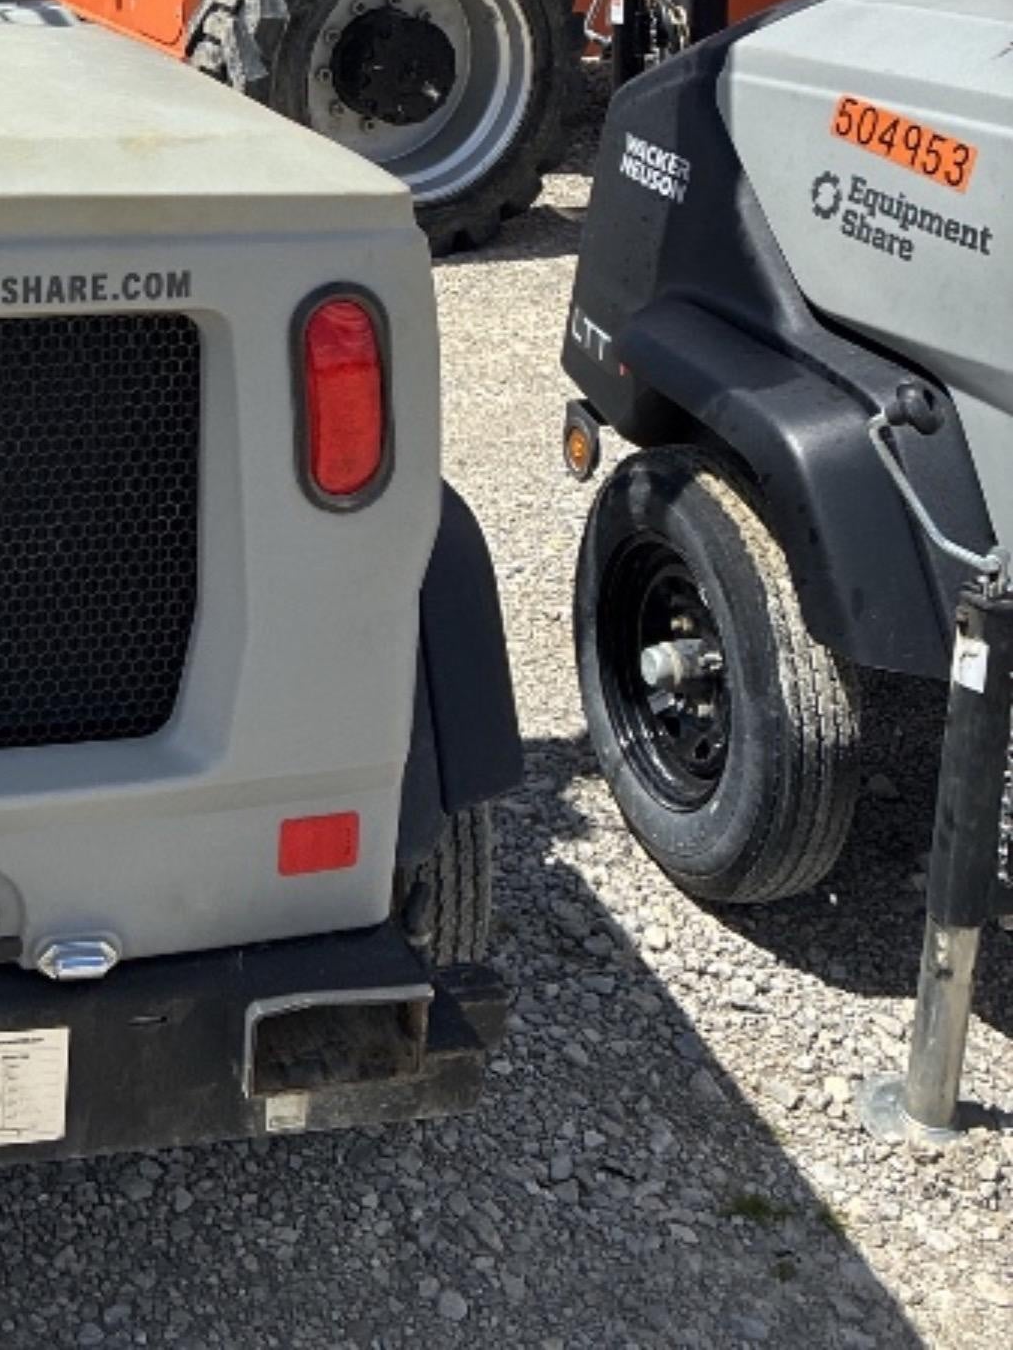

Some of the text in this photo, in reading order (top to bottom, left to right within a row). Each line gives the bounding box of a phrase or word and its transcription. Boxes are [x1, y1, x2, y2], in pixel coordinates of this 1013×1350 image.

[625, 131, 691, 183] WACKER
[835, 97, 972, 188] 504953
[619, 154, 688, 205] NEUSON
[841, 210, 915, 262] Share
[847, 173, 994, 256] Equipment
